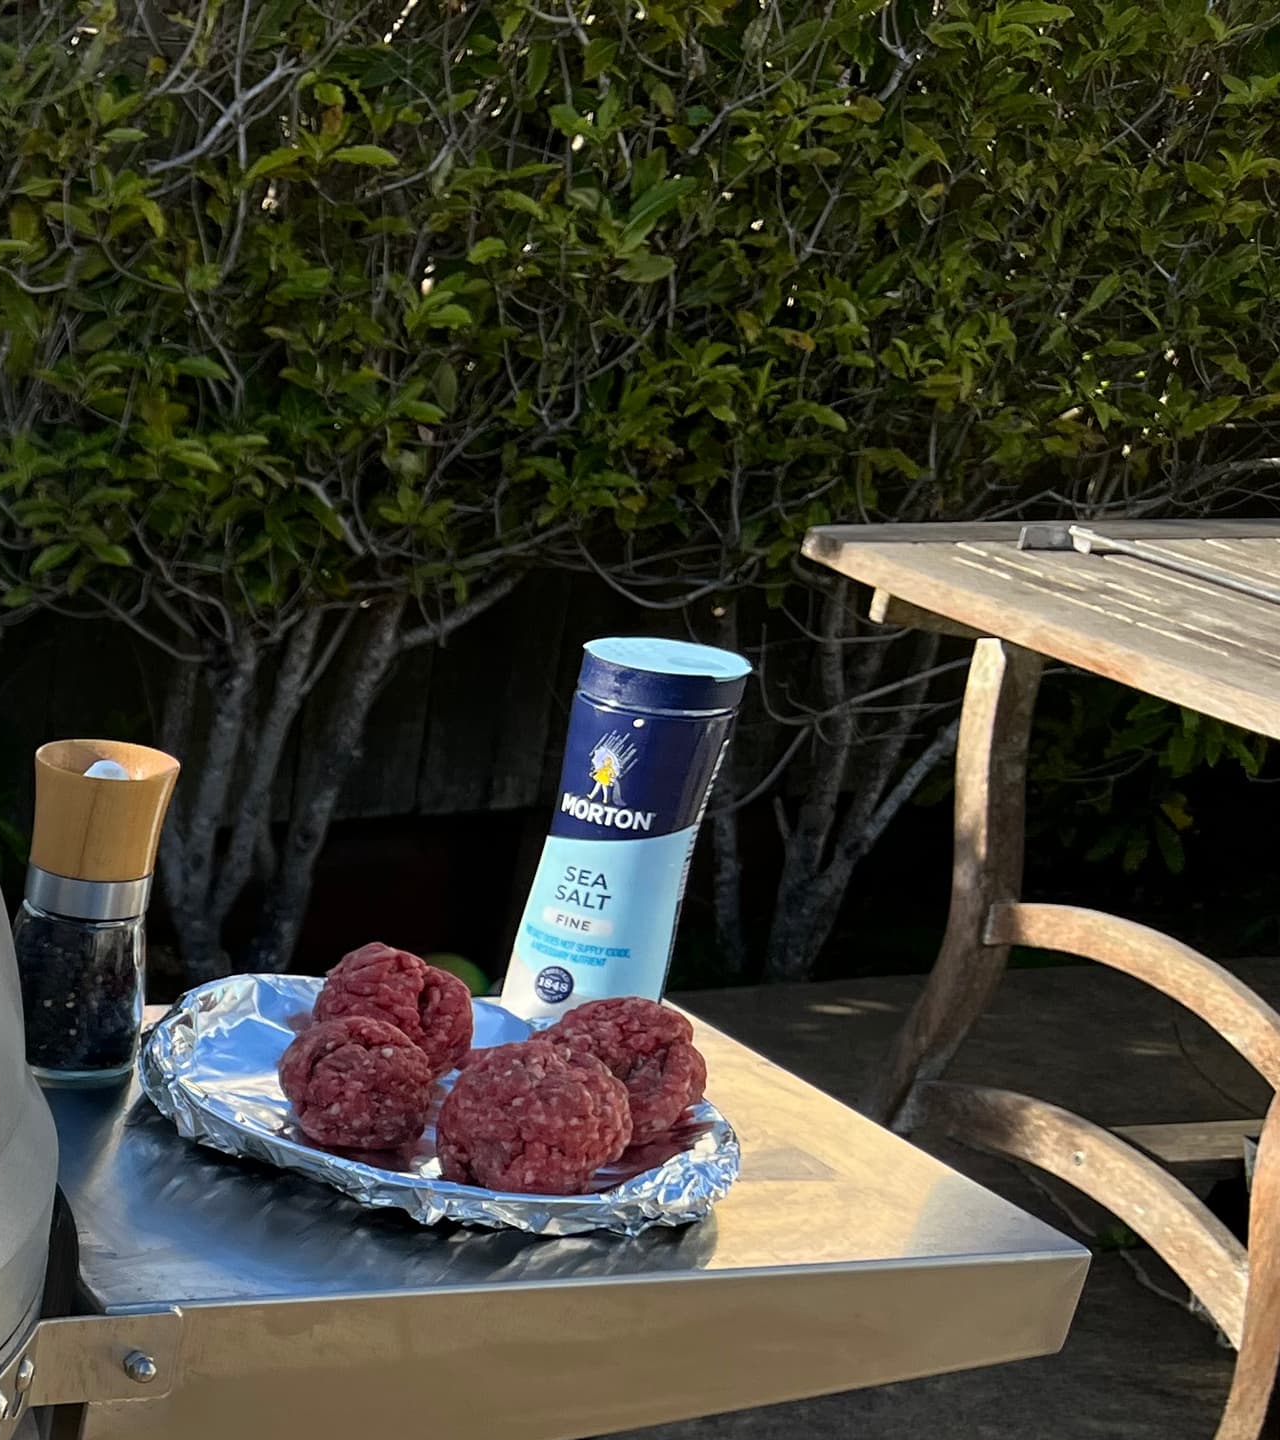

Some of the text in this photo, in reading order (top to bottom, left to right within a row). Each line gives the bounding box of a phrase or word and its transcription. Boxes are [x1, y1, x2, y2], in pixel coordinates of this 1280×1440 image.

[561, 792, 653, 831] MORTON
[564, 866, 608, 890] SEA
[555, 884, 612, 911] SALT
[555, 914, 591, 932] FINE
[538, 976, 569, 993] 1848
